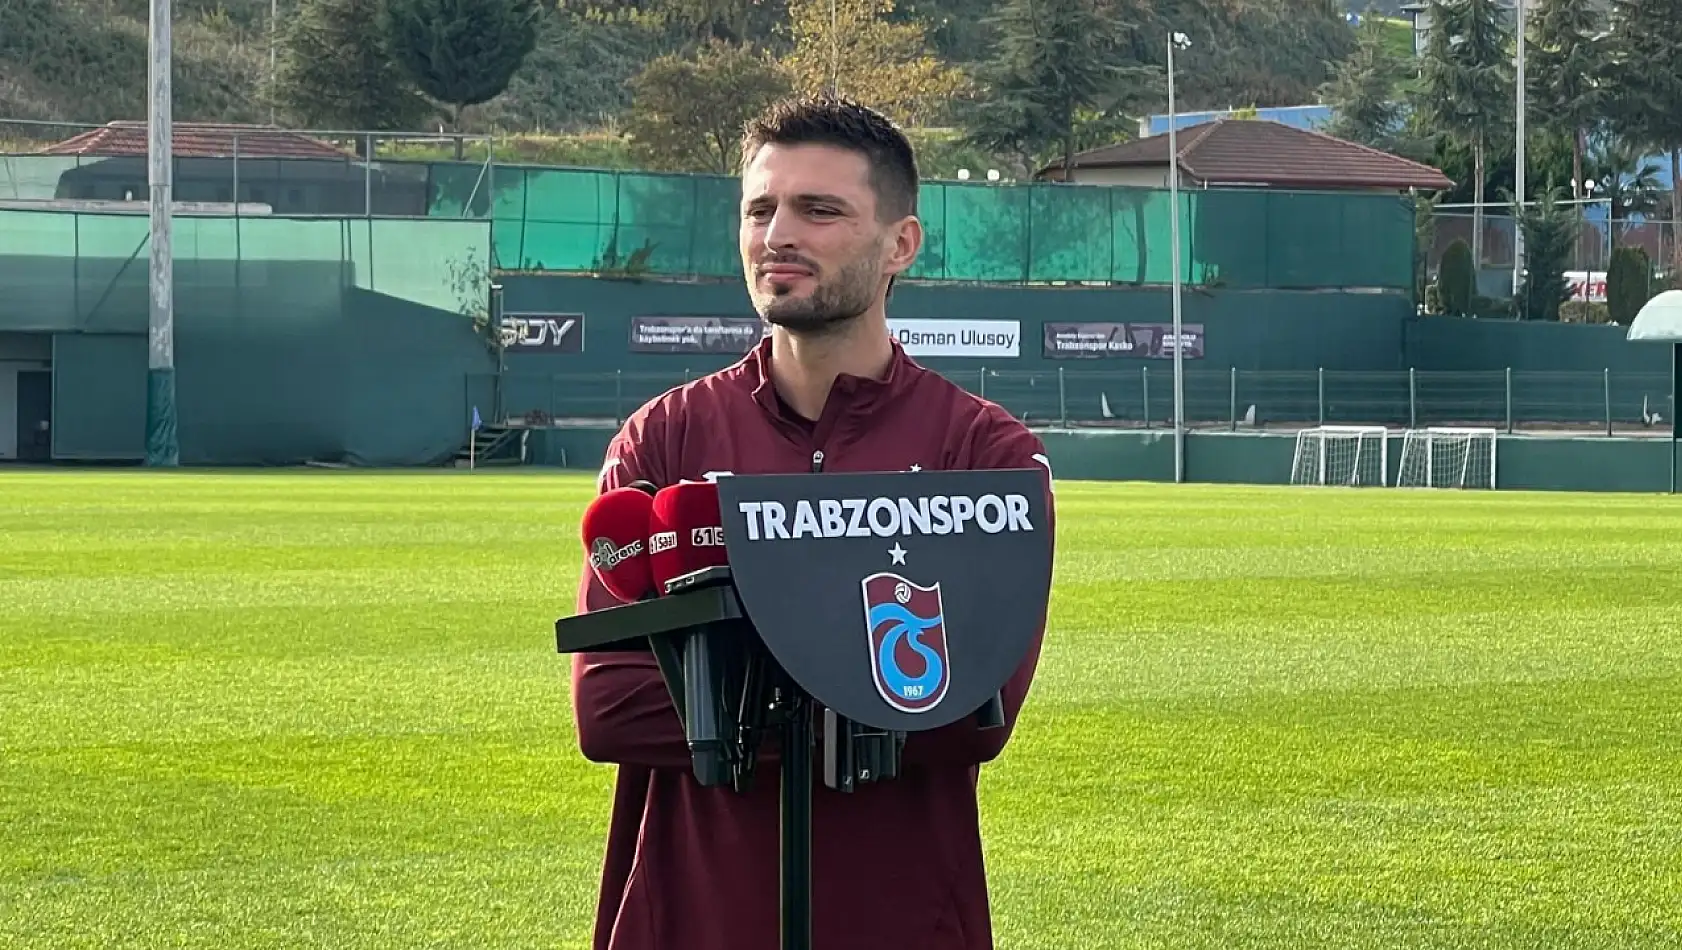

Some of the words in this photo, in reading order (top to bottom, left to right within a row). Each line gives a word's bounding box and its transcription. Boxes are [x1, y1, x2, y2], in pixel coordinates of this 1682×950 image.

[899, 329, 956, 345] Osman
[961, 329, 1015, 348] Ulusoy
[739, 494, 1033, 541] TRABZONSPOR
[903, 685, 924, 697] 1967
